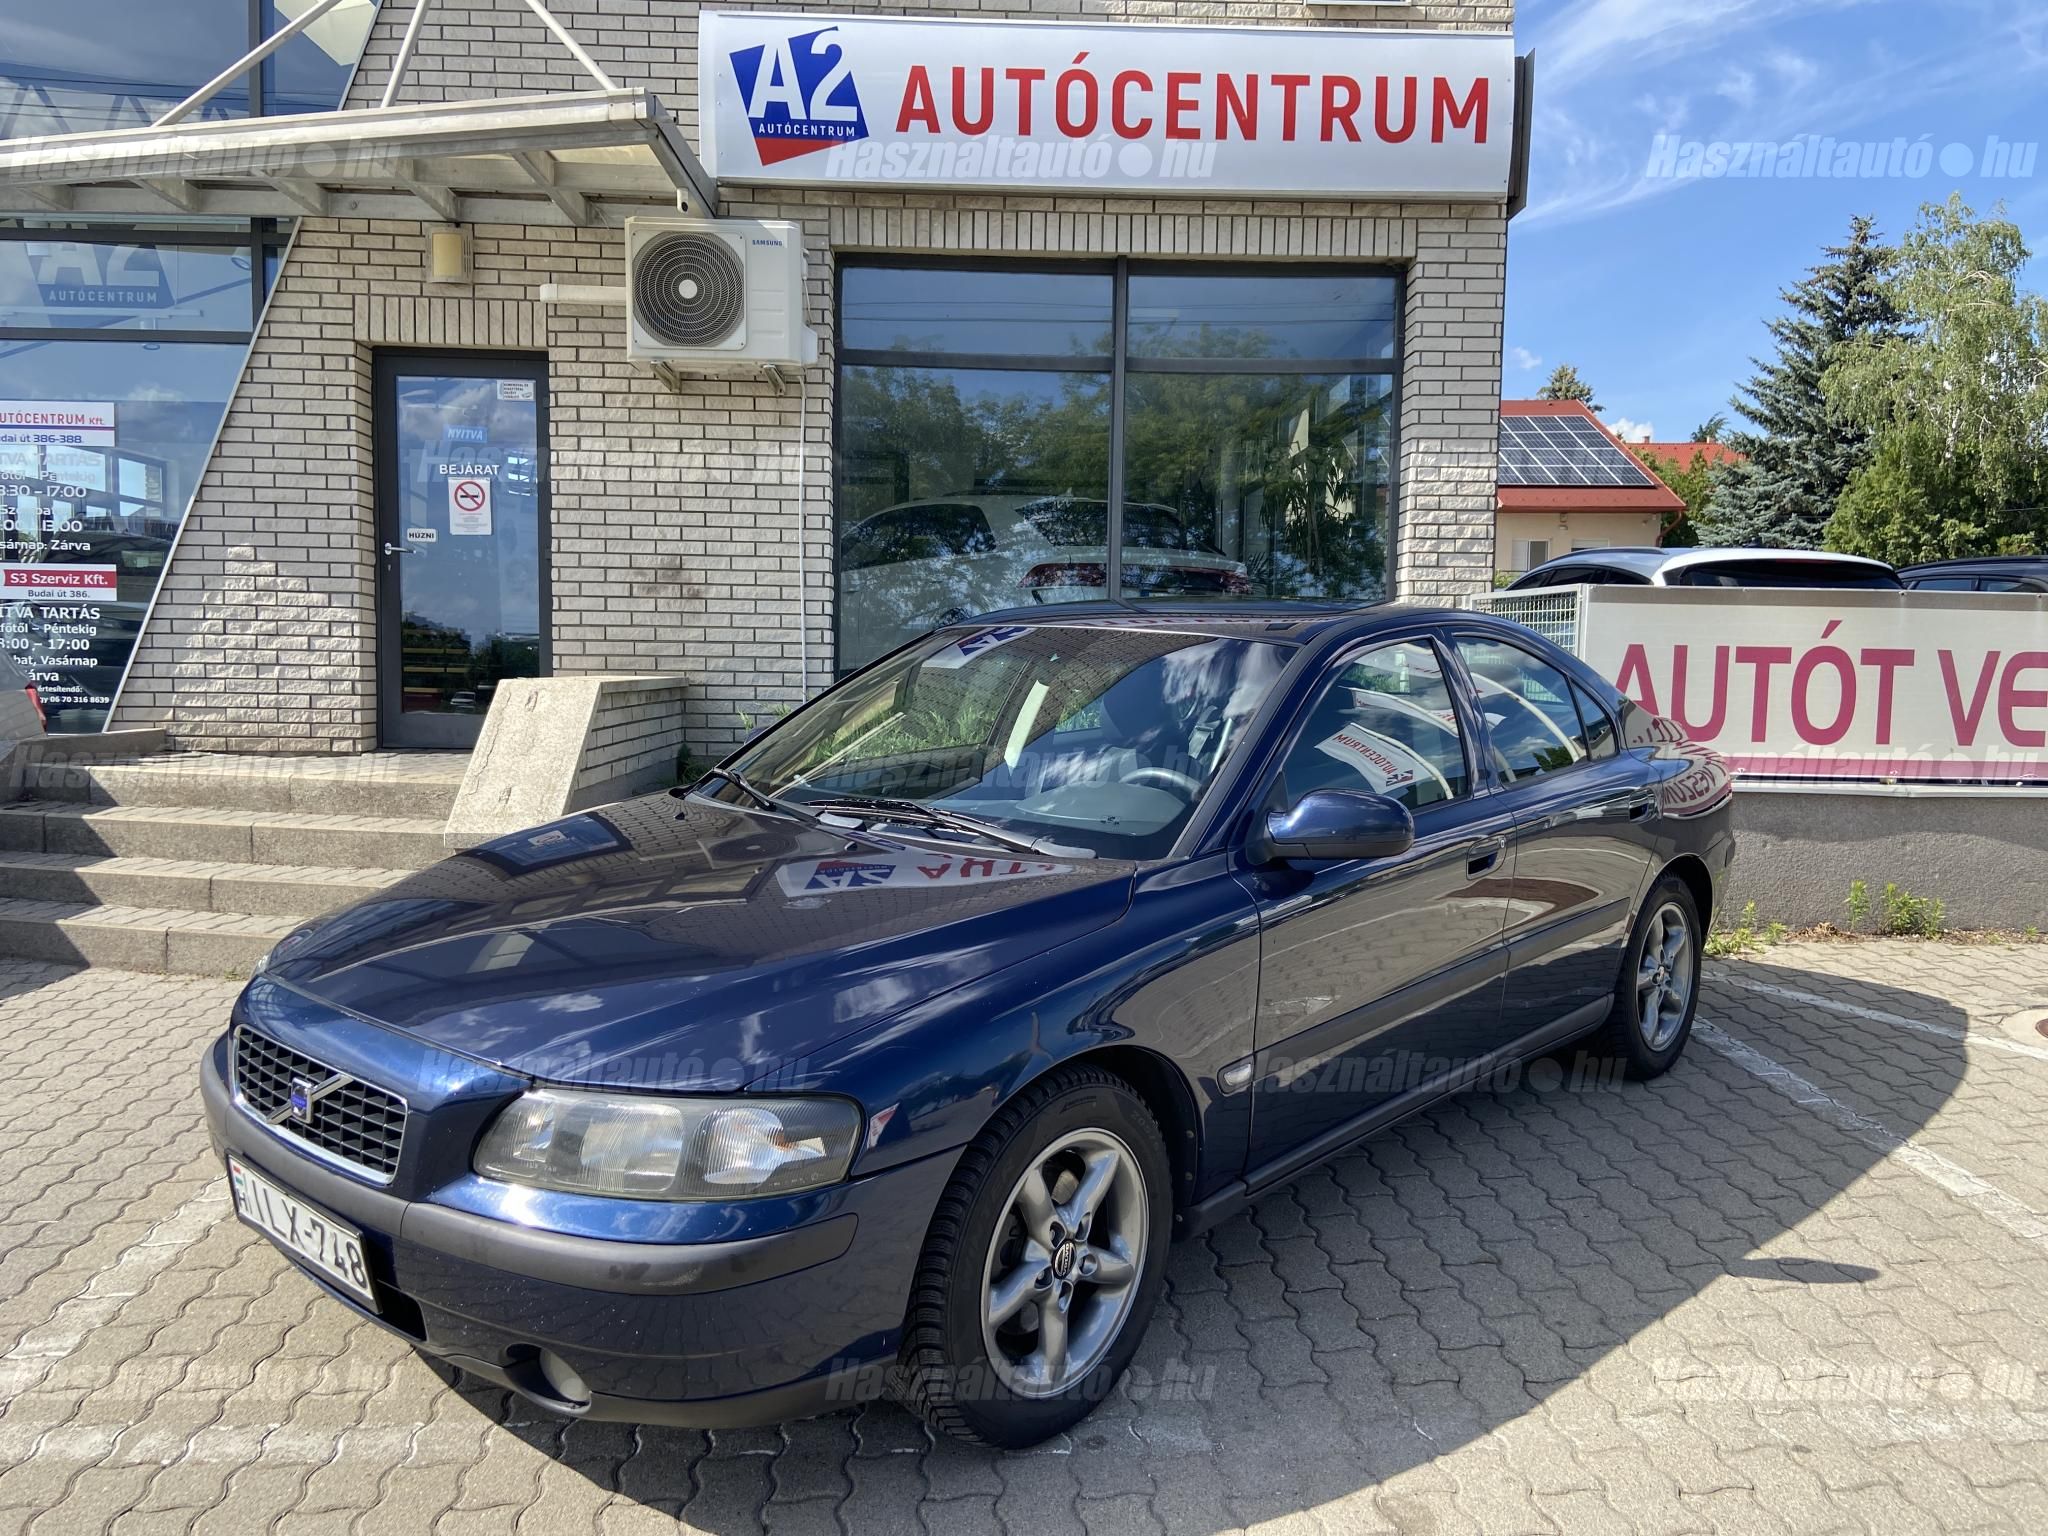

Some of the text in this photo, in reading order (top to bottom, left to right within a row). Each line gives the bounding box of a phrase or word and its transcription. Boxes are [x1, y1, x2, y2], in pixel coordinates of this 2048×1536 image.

[748, 29, 858, 122] A2
[896, 52, 1489, 144] AUTÓCENTRUM
[758, 122, 855, 136] AUTÓCENTRUM
[752, 239, 783, 247] SAMSUNG
[49, 288, 157, 303] AUTÓCENTRUM
[447, 428, 483, 440] NYITVA
[439, 462, 500, 475] BEJÁRAT
[47, 485, 87, 498] 17:00
[51, 539, 91, 551] Zárva
[10, 573, 108, 585] S3 Szerviz Kft.
[28, 589, 90, 598] Budai út 386.
[41, 604, 100, 620] TARTÁS
[44, 623, 97, 636] Péntekig
[48, 639, 90, 650] 17:00
[41, 655, 98, 668] Vasárnap
[25, 669, 60, 681] árva
[1614, 620, 1915, 746] AUTÓT
[1937, 649, 2048, 748] VE
